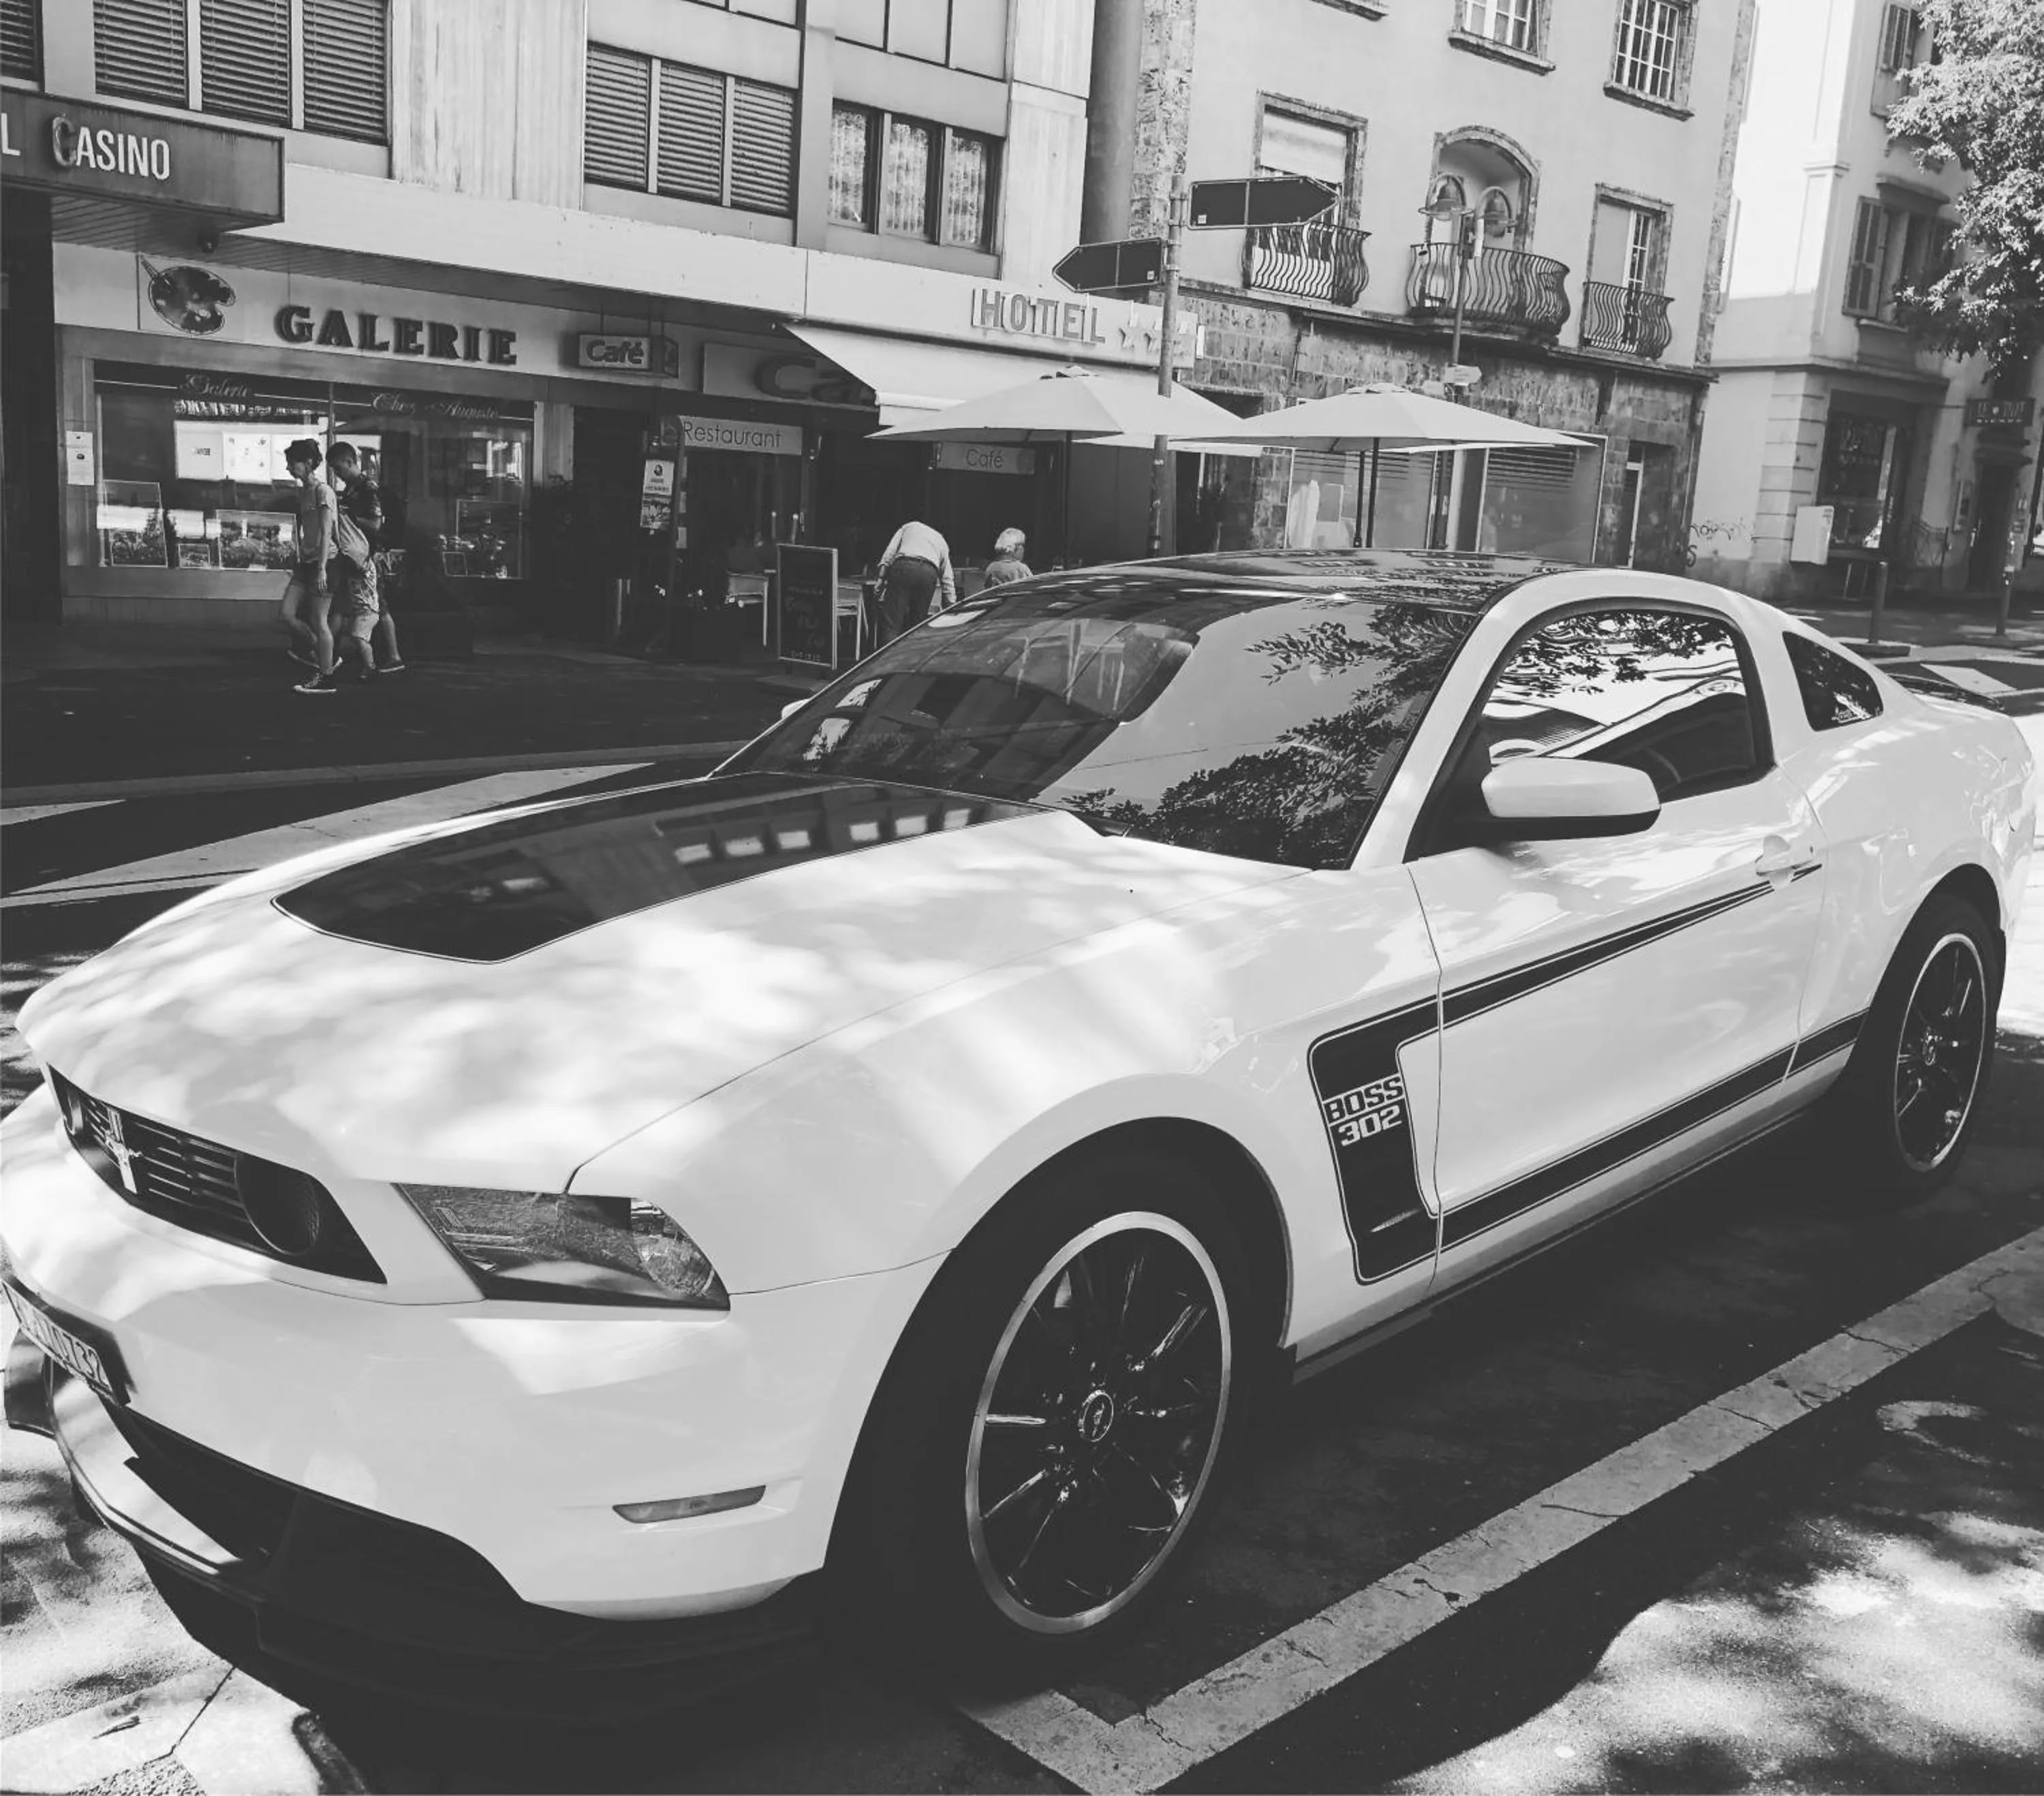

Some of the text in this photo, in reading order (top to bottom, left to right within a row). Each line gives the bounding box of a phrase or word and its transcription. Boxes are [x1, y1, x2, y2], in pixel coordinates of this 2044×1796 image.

[52, 116, 170, 180] CASINO
[273, 305, 516, 365] GALERIE
[973, 288, 1105, 343] HOTEL
[587, 339, 644, 364] Café
[683, 420, 781, 448] Restaurant
[966, 449, 1002, 469] Café
[1325, 1076, 1403, 1122] BOSS
[1338, 1105, 1402, 1146] 302
